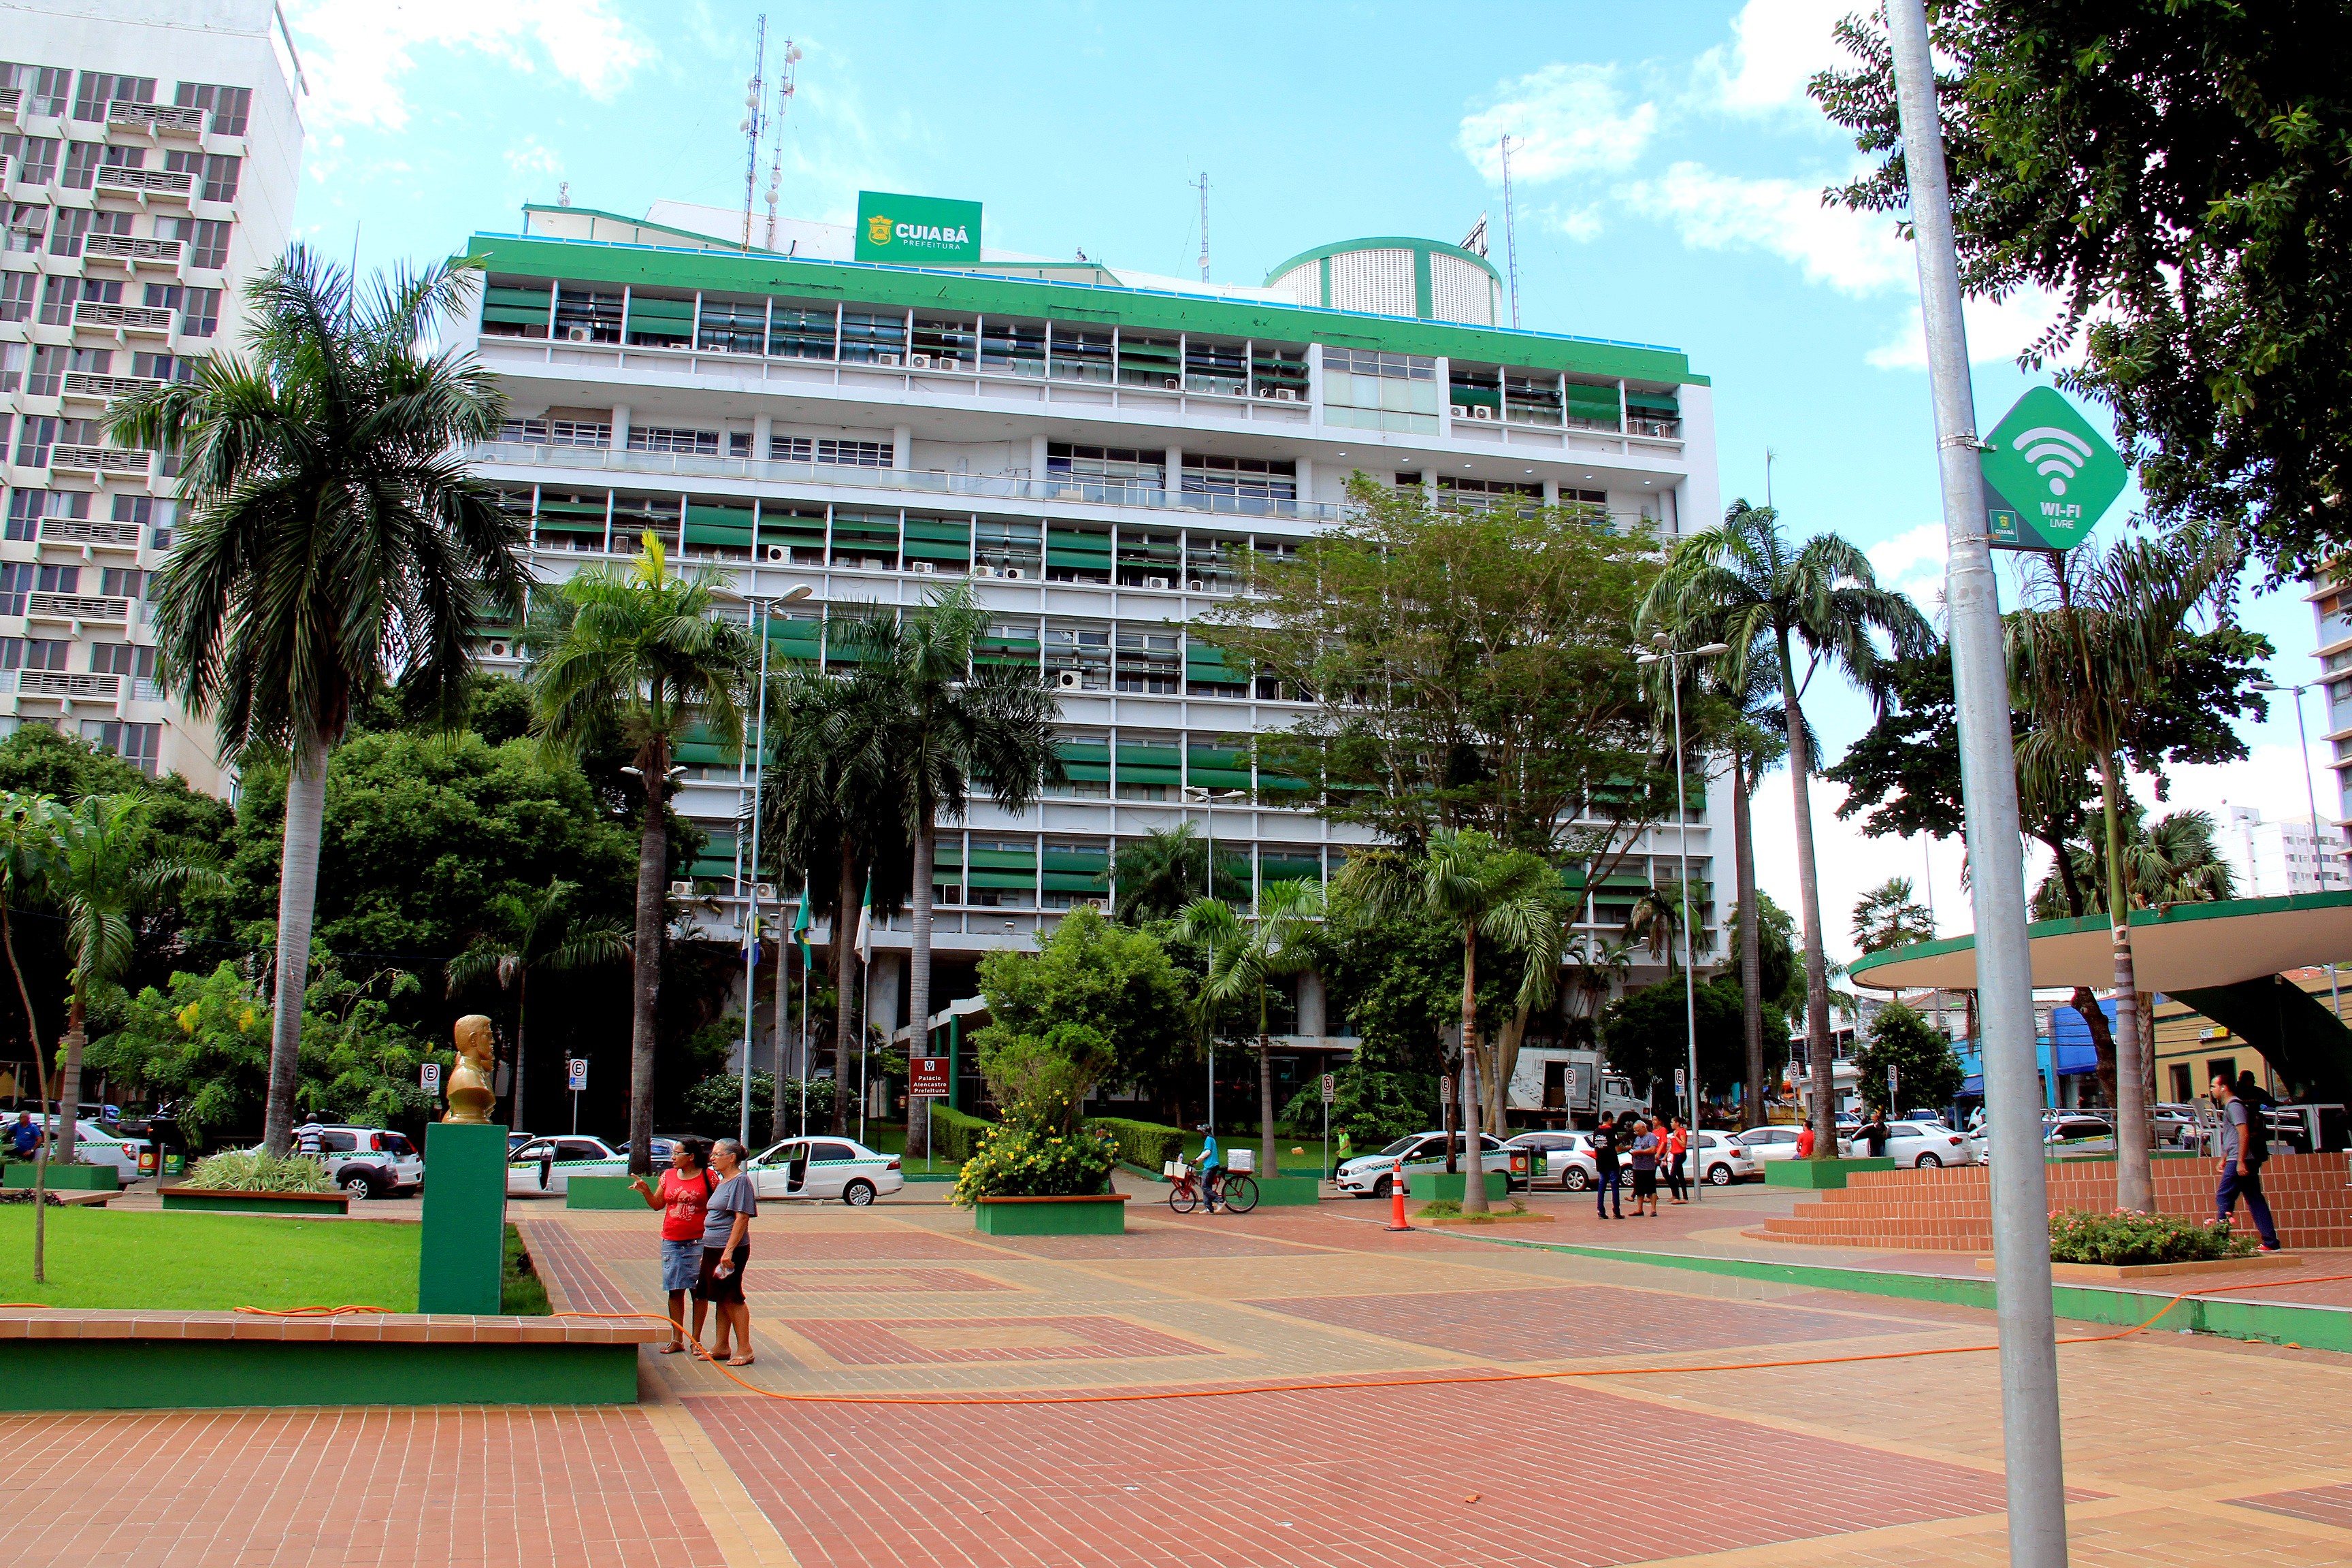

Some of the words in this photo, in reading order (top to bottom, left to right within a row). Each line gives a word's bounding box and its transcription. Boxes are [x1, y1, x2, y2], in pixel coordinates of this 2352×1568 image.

[895, 225, 969, 244] CUIABÁ
[903, 240, 961, 250] PREFEITURA
[2040, 502, 2081, 519] WI-FI
[2049, 519, 2074, 529] LIVRE
[427, 1068, 434, 1079] E
[576, 1064, 581, 1073] E
